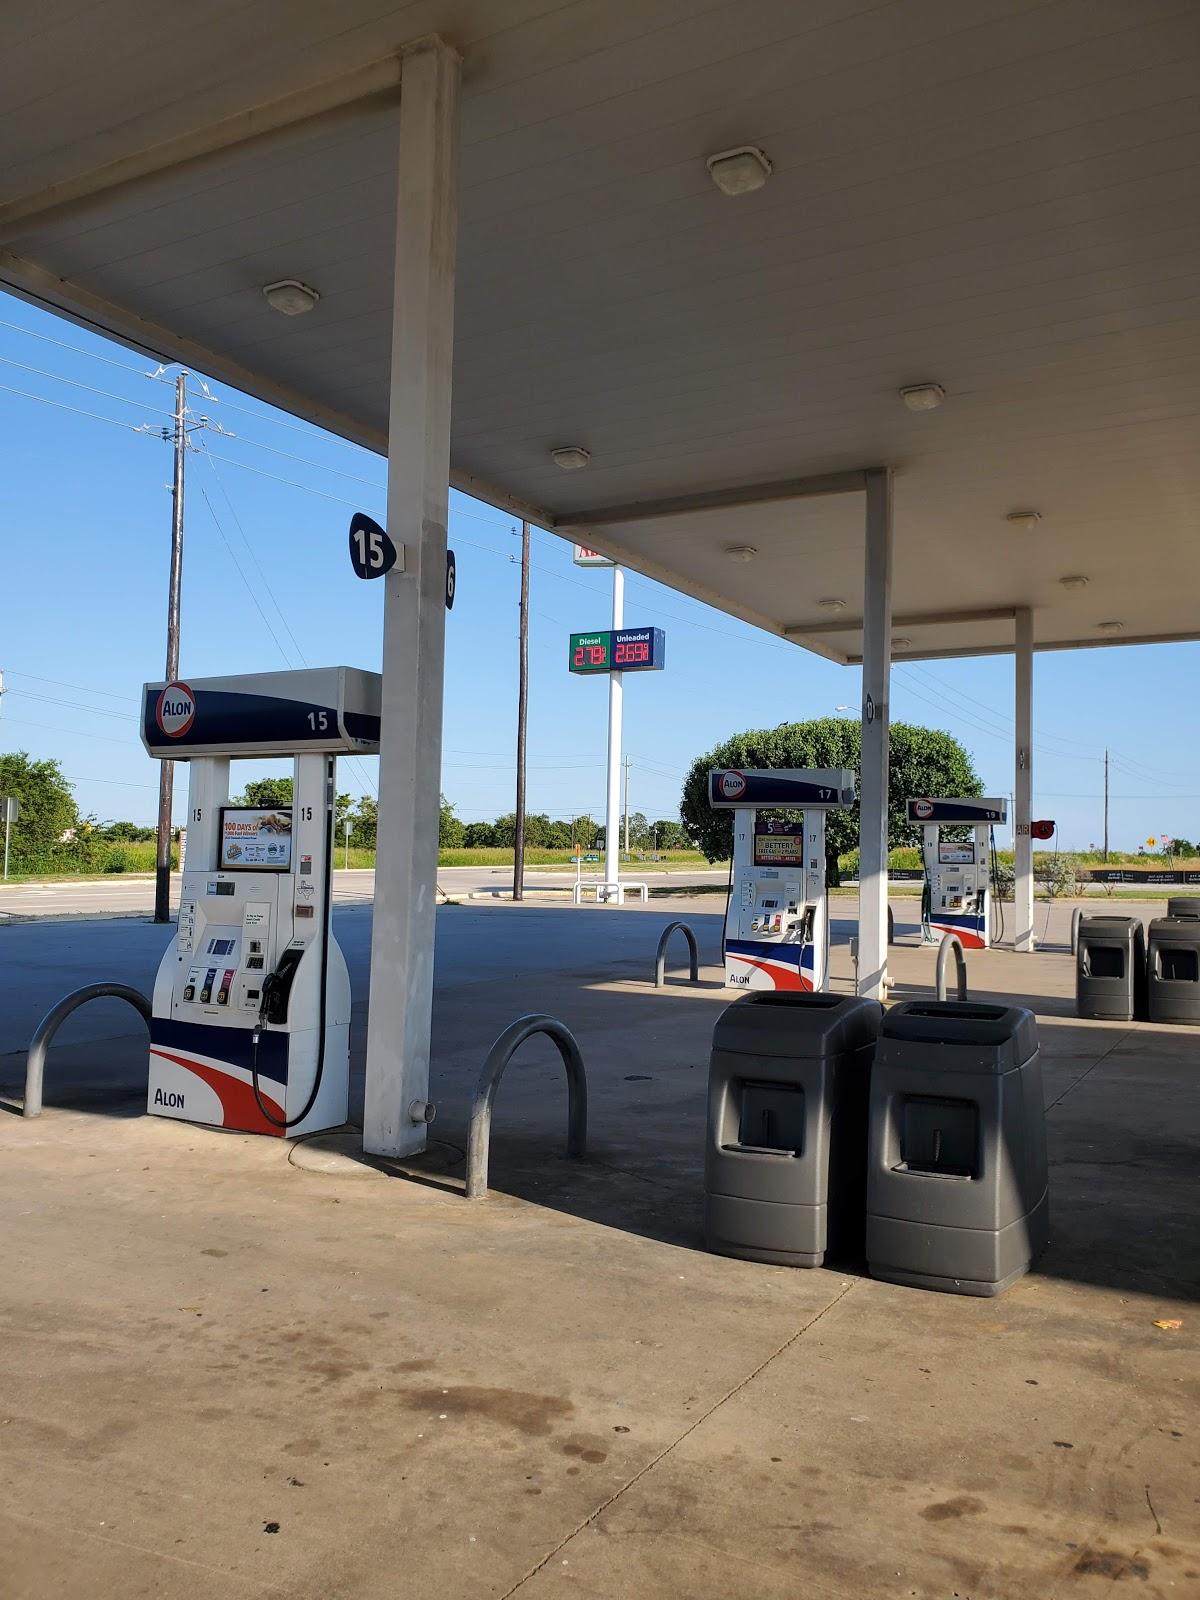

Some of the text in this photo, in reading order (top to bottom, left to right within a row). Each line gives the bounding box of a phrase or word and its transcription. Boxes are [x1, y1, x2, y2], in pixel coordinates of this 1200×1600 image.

[353, 530, 384, 568] 15
[447, 566, 454, 597] 6
[579, 637, 601, 646] Diesel
[616, 633, 650, 643] Unleaded
[163, 701, 192, 717] ALON
[307, 711, 328, 731] 15
[724, 778, 744, 789] ALON
[818, 789, 832, 800] 17
[193, 808, 202, 822] 15
[301, 807, 312, 821] 15
[985, 811, 996, 819] 19
[225, 822, 236, 831] 100
[237, 823, 252, 831] DAYS
[1016, 825, 1029, 835] AIR
[738, 833, 745, 841] 17
[809, 834, 817, 843] 17
[729, 974, 750, 984] ALON
[154, 1088, 185, 1109] ALON
